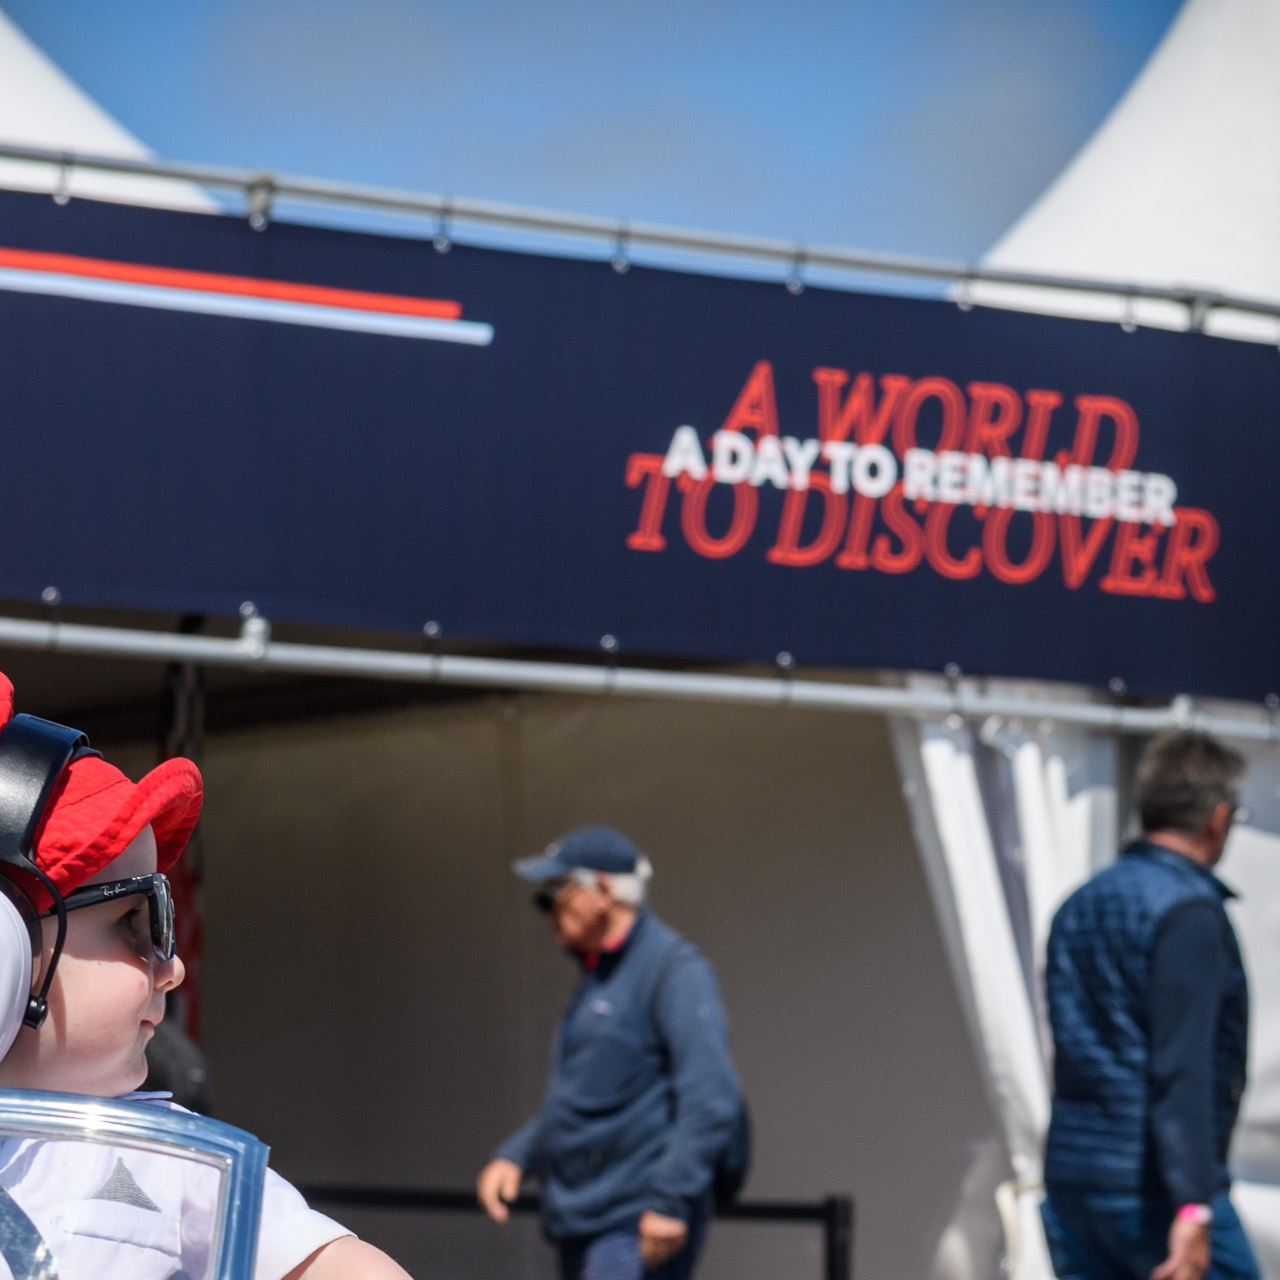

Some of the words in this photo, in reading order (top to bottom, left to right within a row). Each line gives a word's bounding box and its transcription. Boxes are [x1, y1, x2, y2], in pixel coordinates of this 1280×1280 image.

[712, 360, 780, 450] A
[812, 367, 1140, 474] WORLD
[626, 452, 759, 559] TO
[767, 470, 1220, 602] DISCOVER
[663, 425, 706, 480] A
[713, 430, 821, 490] DAY
[821, 440, 897, 499] TO
[904, 447, 1177, 526] REMEMBER
